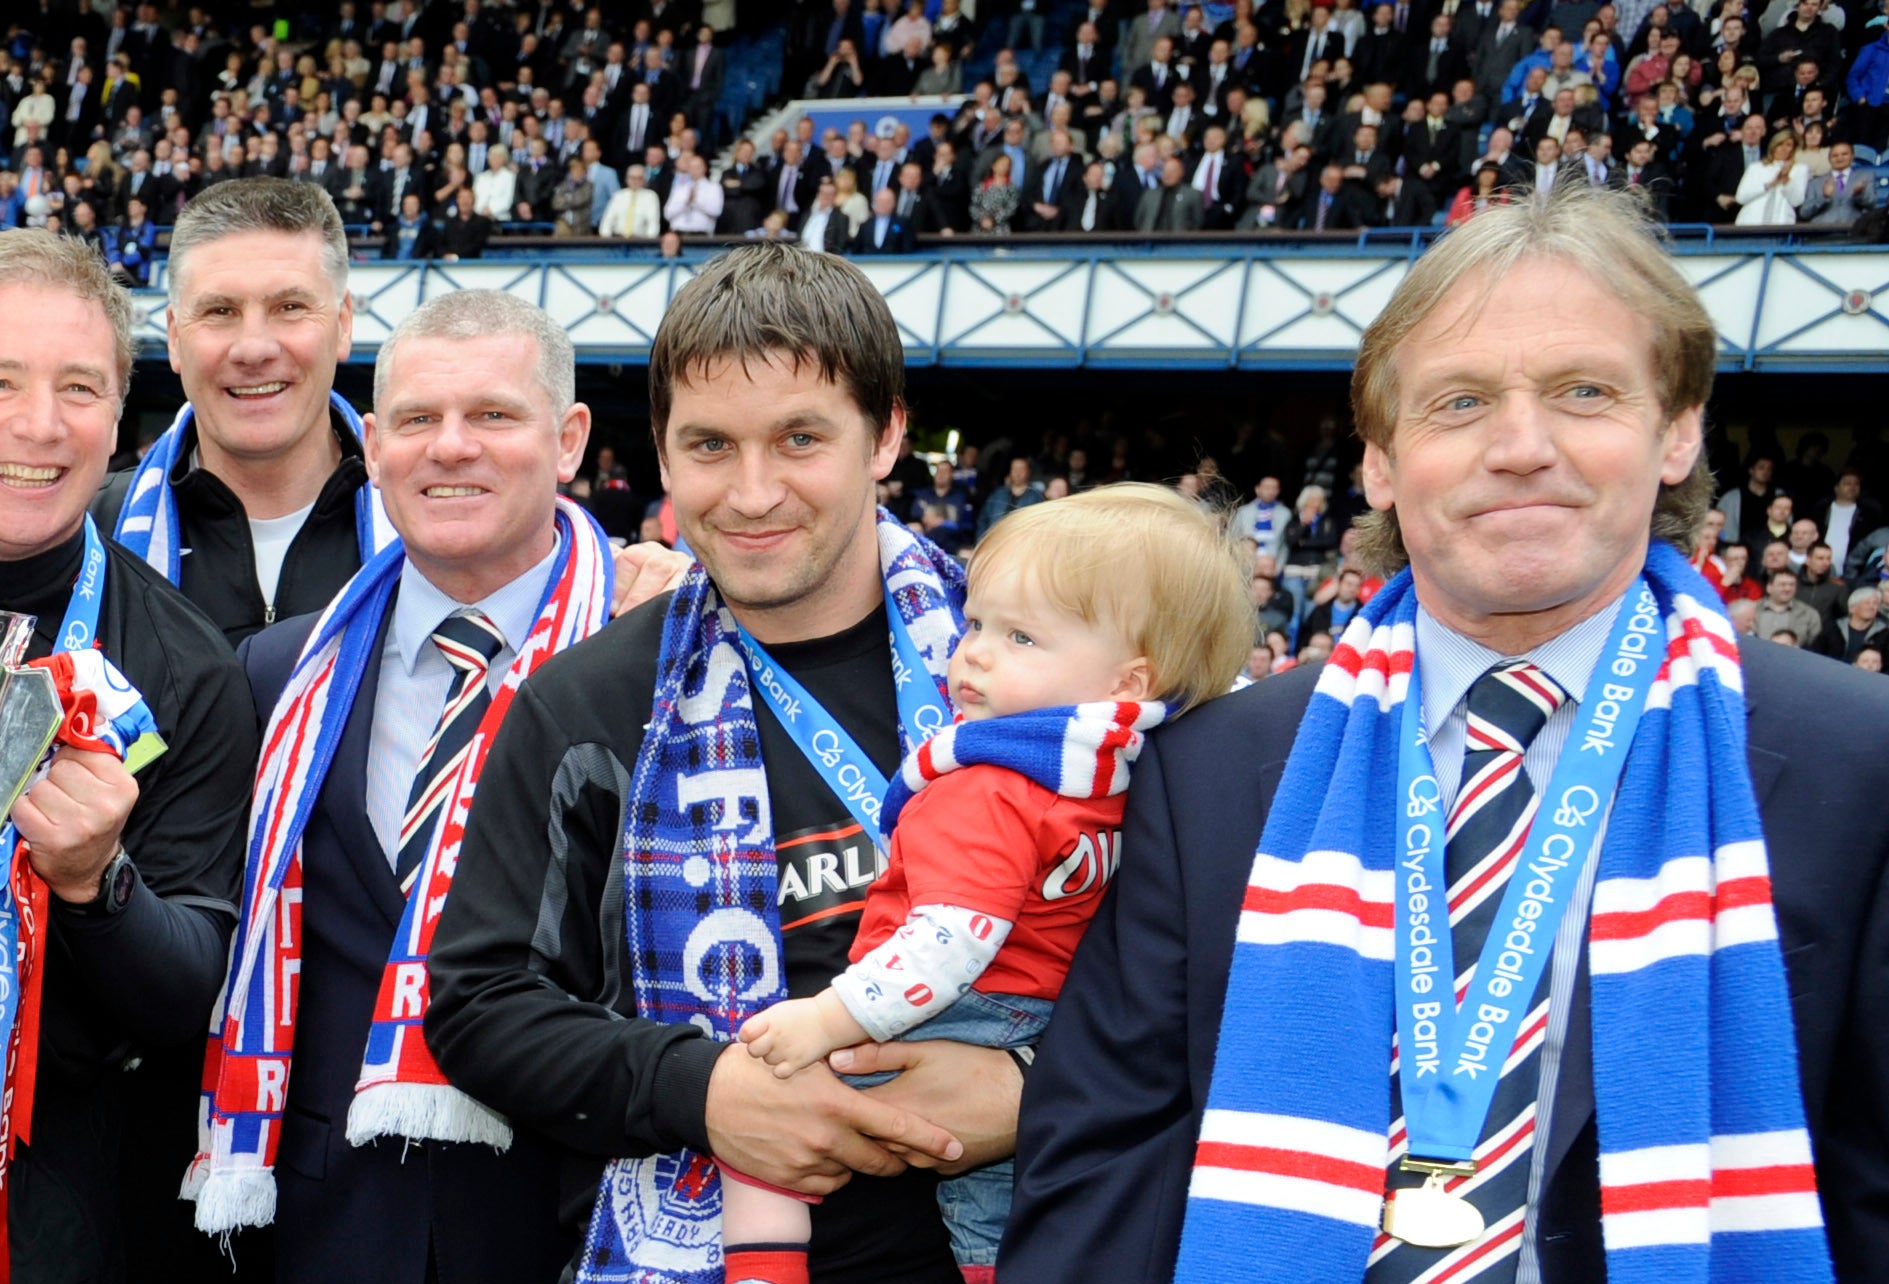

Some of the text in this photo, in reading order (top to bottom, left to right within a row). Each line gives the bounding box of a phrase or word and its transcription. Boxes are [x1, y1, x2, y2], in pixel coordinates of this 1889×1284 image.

[79, 548, 103, 600] Bank
[760, 667, 802, 723] Bank
[1581, 683, 1634, 755] Bank
[1402, 823, 1436, 993] Clydesdale
[1488, 832, 1575, 997] Clydesdale
[1412, 1002, 1440, 1078] Bank
[1455, 1003, 1509, 1080] Bank
